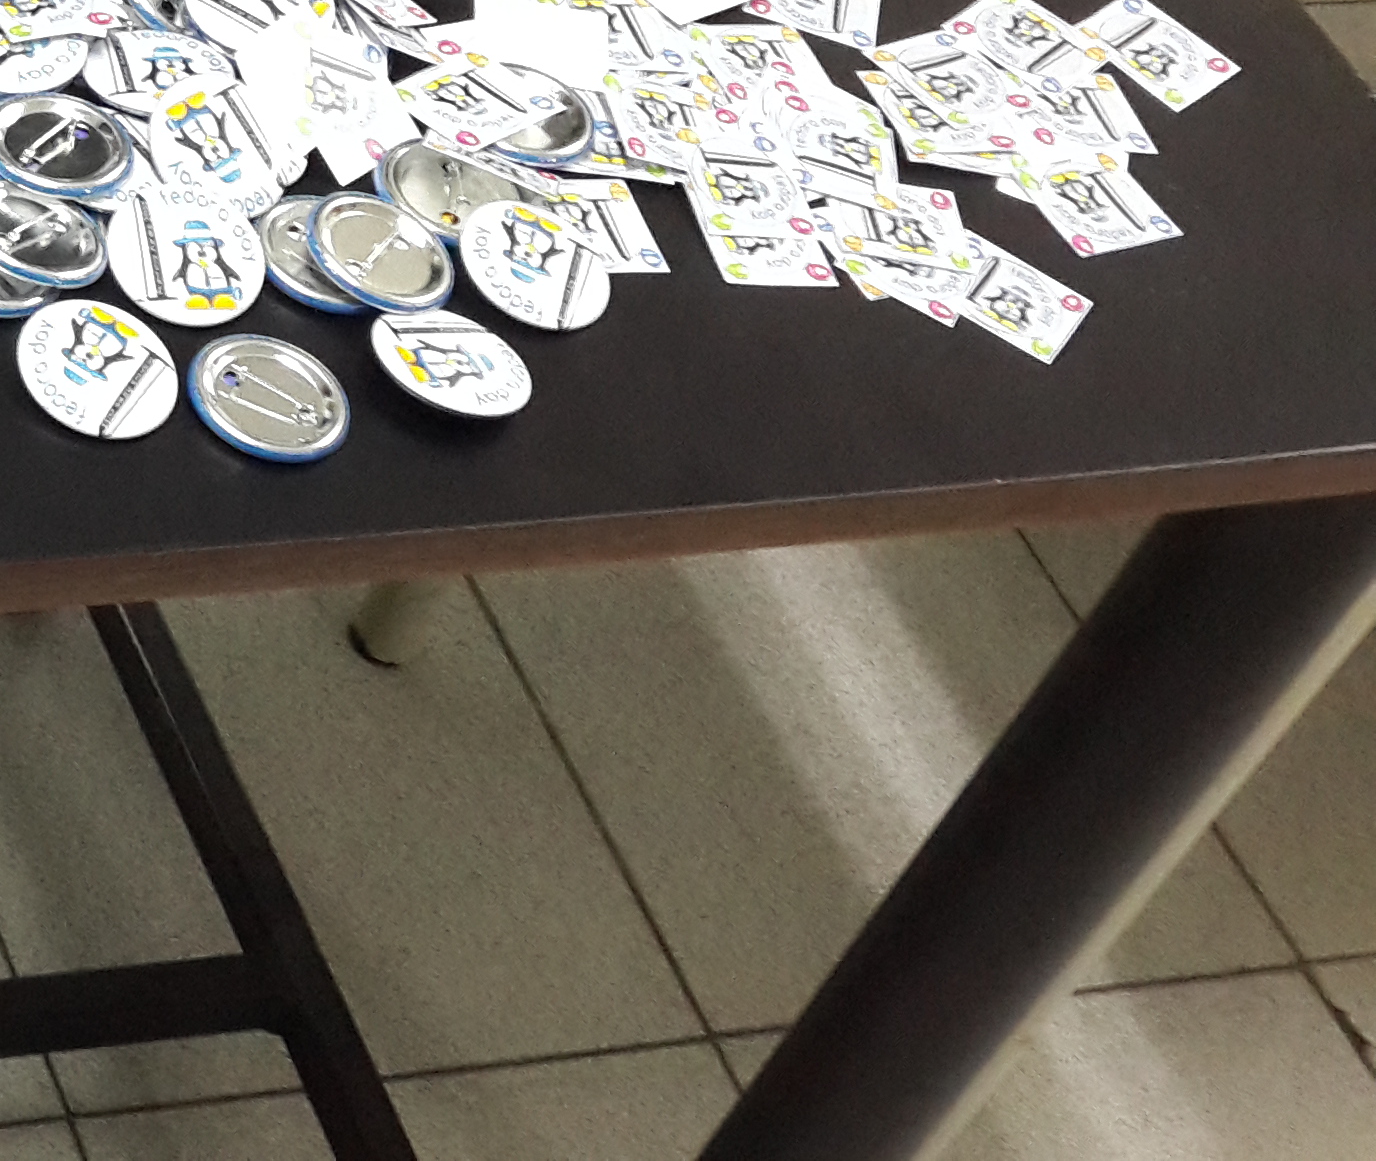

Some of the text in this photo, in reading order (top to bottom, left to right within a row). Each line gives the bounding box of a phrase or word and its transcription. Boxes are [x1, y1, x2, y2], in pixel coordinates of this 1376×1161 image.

[484, 266, 544, 323] fedora
[27, 319, 87, 426] fedora day
